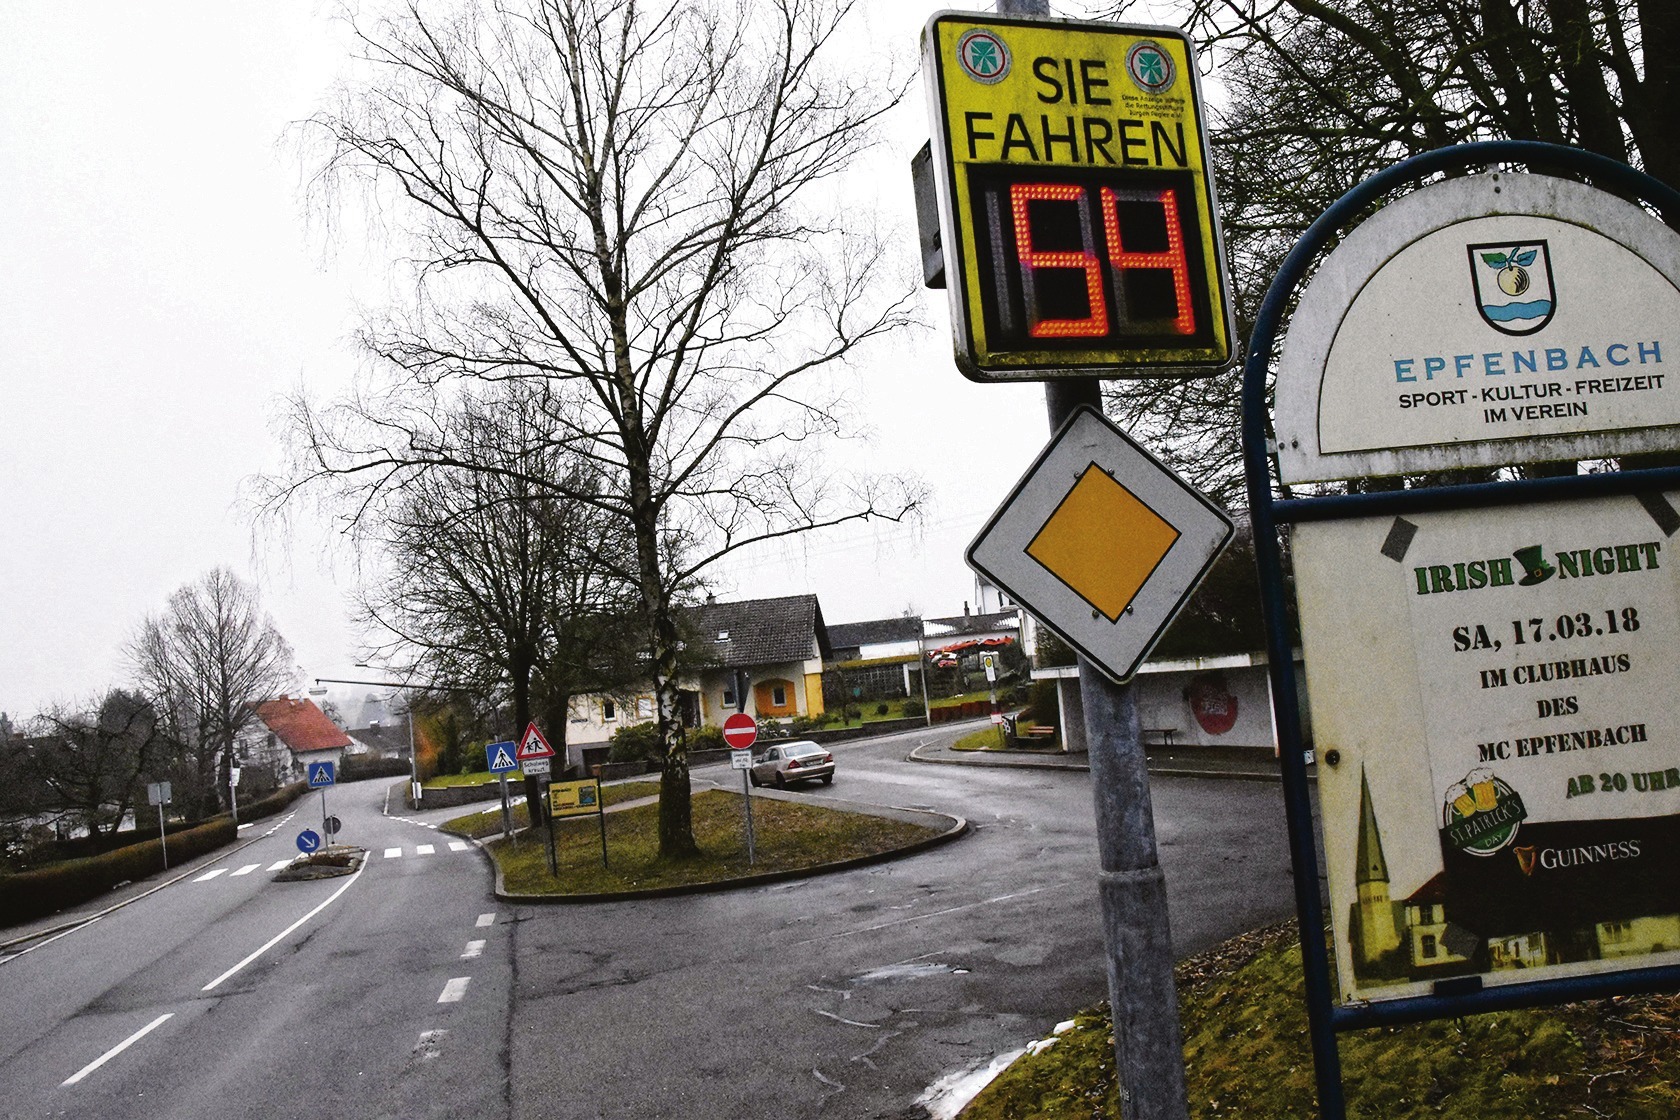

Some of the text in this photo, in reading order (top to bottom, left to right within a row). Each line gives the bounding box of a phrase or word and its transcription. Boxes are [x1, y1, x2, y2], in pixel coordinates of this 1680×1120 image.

[1032, 57, 1112, 106] SIE
[964, 111, 1188, 167] FAHREN
[1010, 182, 1195, 338] 54
[1394, 341, 1662, 383] EPFENBACH
[1399, 389, 1469, 408] SPORT
[1481, 382, 1562, 402] KULTUR
[1575, 374, 1665, 395] FREIZEIT
[1484, 401, 1588, 424] IM VEREIN
[1414, 542, 1661, 595] IRISH NIGHT
[1453, 607, 1641, 653] SA, 17.03.18
[1480, 654, 1631, 689] IM CLUBHAUS
[1536, 696, 1579, 719] DES
[1478, 723, 1648, 763] MC EPFENBACH
[1566, 774, 1596, 799] AB
[1599, 772, 1628, 792] 20
[1484, 832, 1503, 847] DAY
[1540, 840, 1640, 869] GUINNESS
